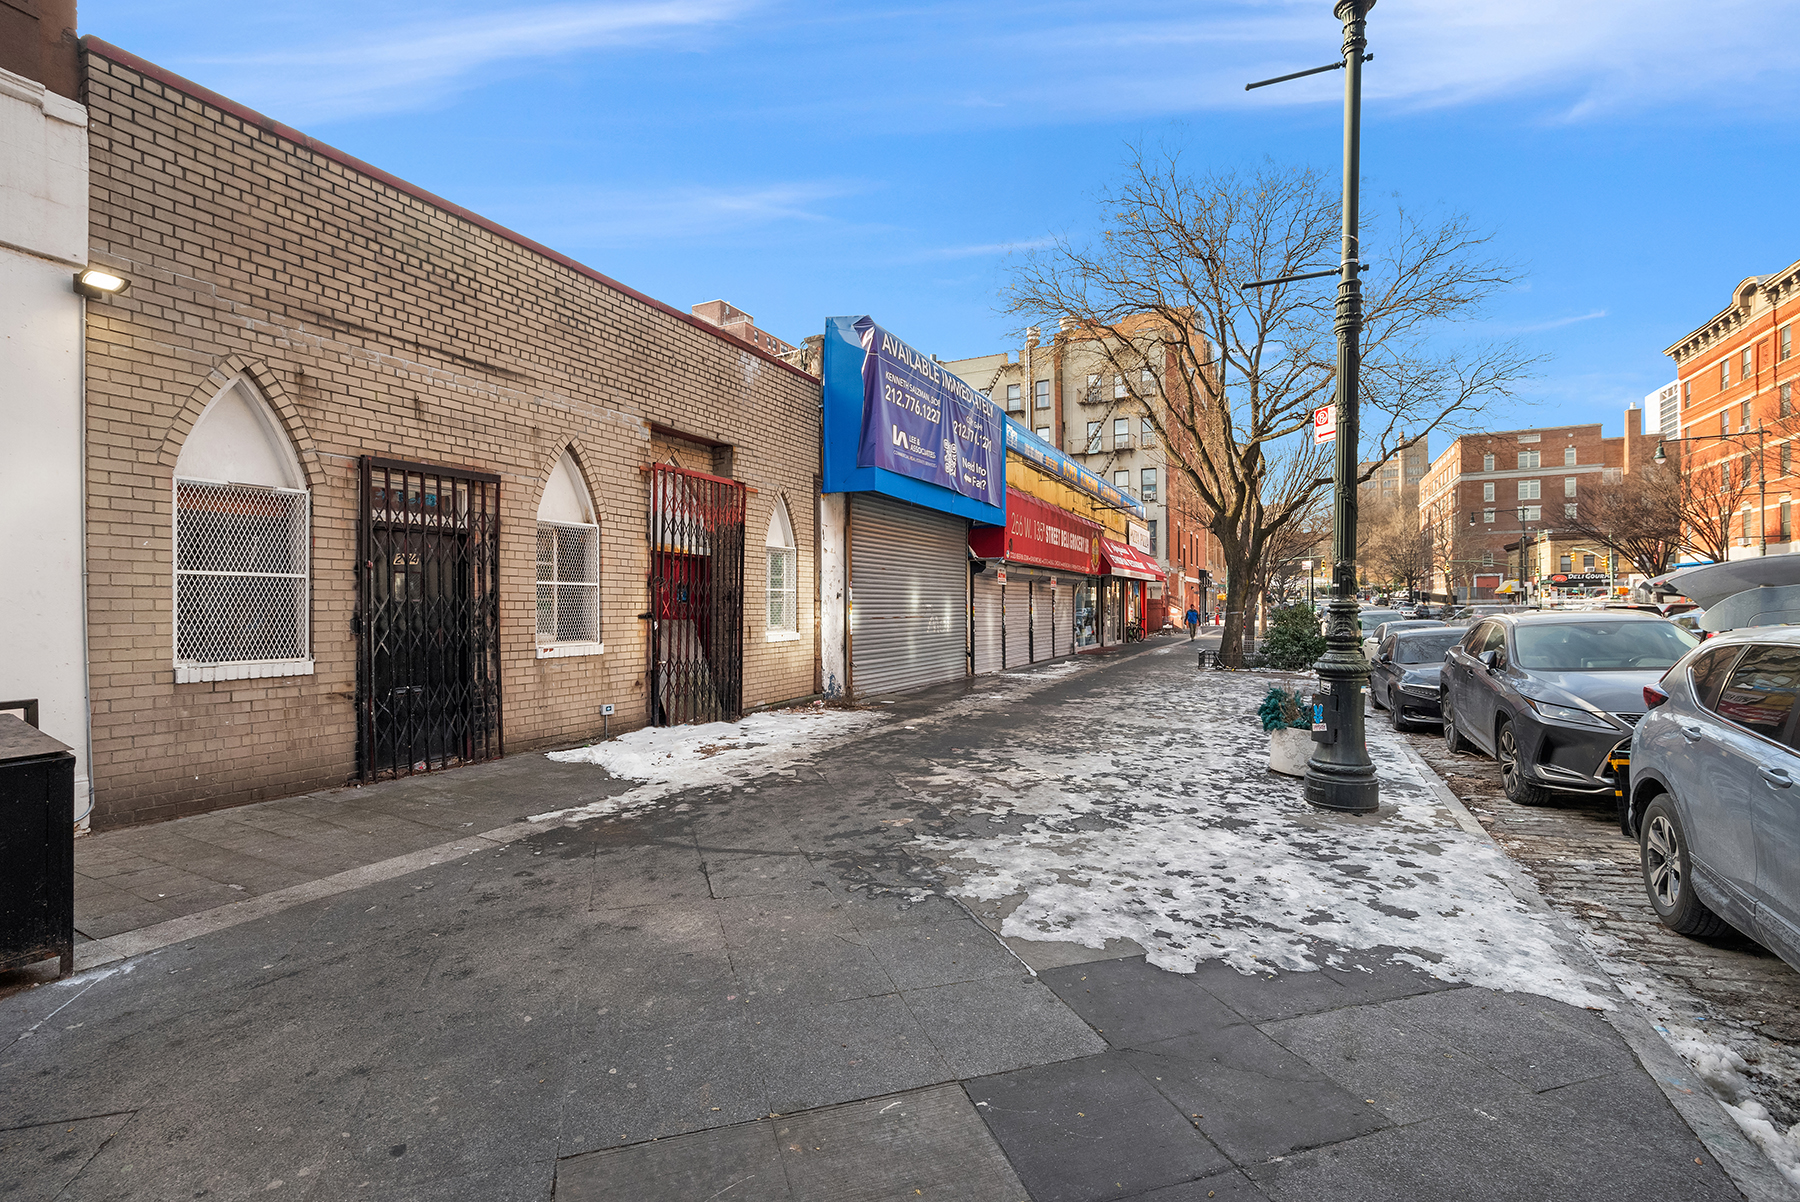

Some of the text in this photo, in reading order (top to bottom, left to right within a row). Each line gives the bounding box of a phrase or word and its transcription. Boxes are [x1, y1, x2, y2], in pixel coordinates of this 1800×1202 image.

[882, 333, 940, 384] AVAILABLE
[885, 371, 909, 389] KENNETH
[885, 384, 941, 425] 212.776.1227
[1011, 512, 1024, 536] 266
[1045, 525, 1061, 547] STREET
[1061, 529, 1070, 549] DELI
